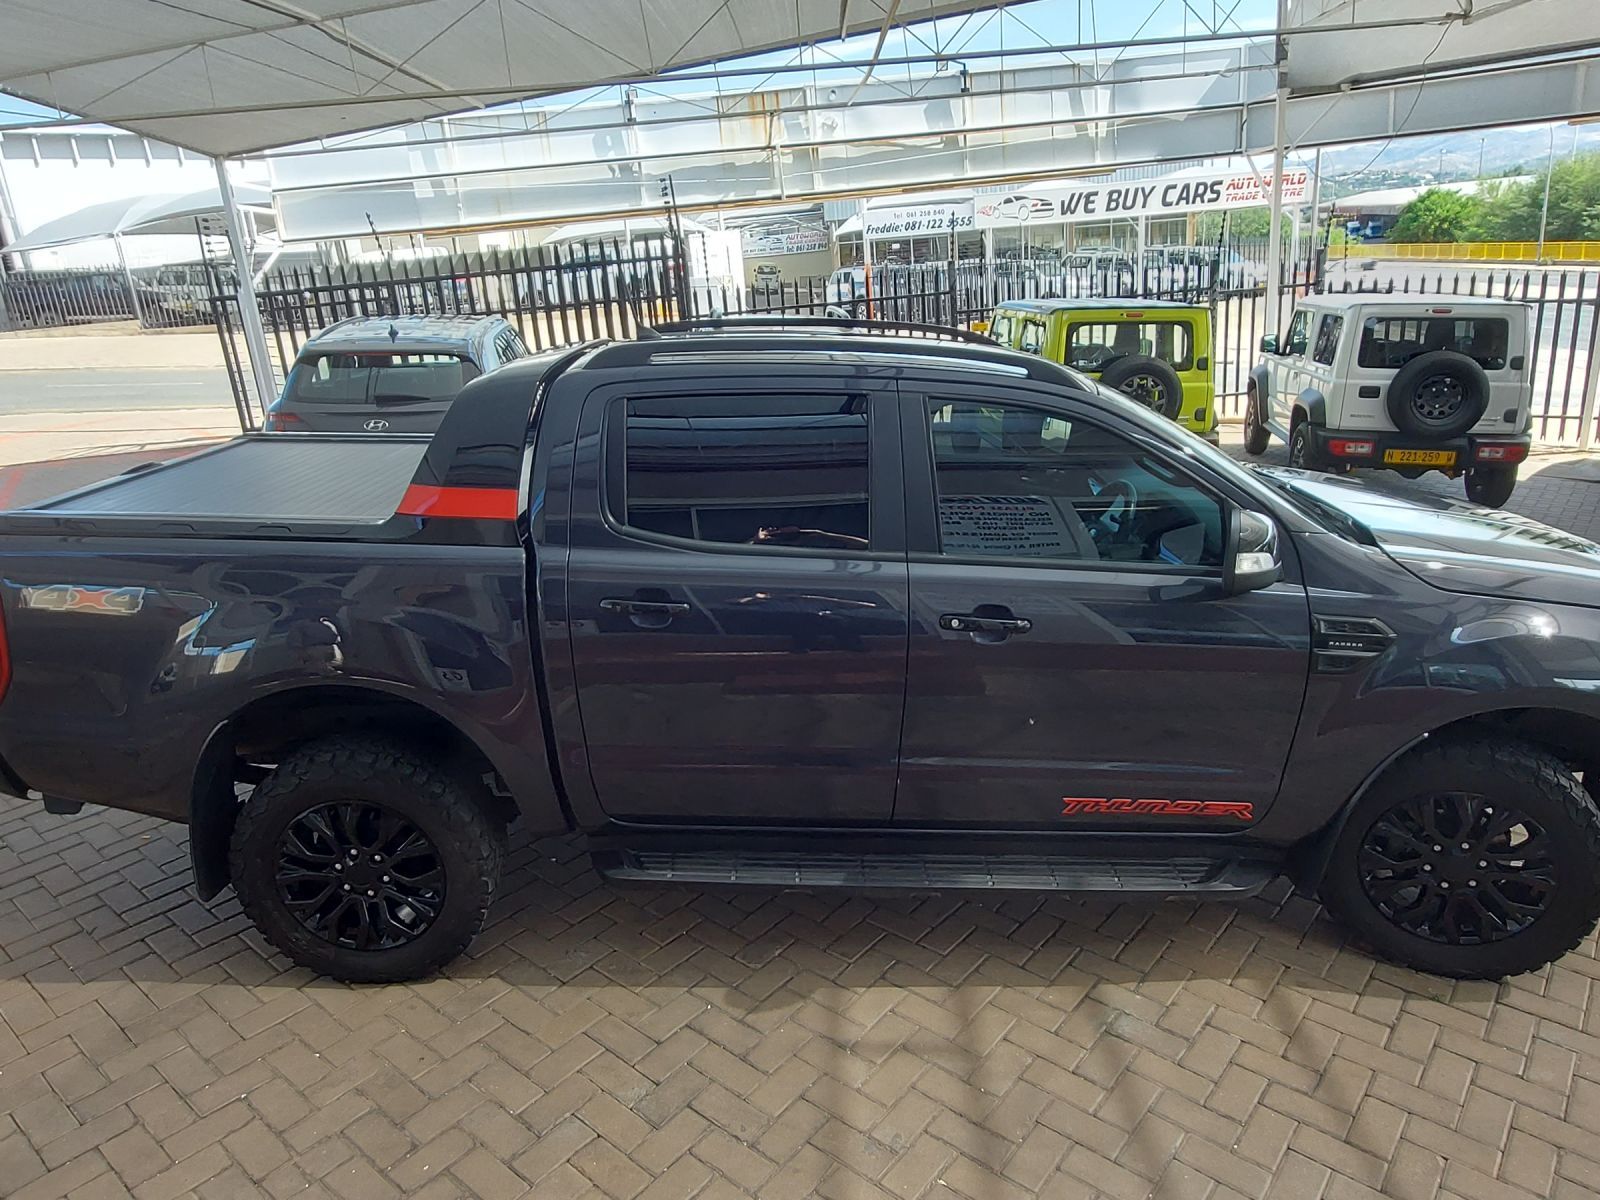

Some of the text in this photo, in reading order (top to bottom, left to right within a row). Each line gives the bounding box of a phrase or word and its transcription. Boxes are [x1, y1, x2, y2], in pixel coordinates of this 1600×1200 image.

[1226, 173, 1307, 191] AUTOWRLD
[1060, 179, 1224, 216] WE BUY CARS
[1226, 191, 1260, 202] TRADE
[1388, 452, 1394, 461] N
[1446, 452, 1455, 463] W
[1061, 797, 1254, 820] THUNDER
